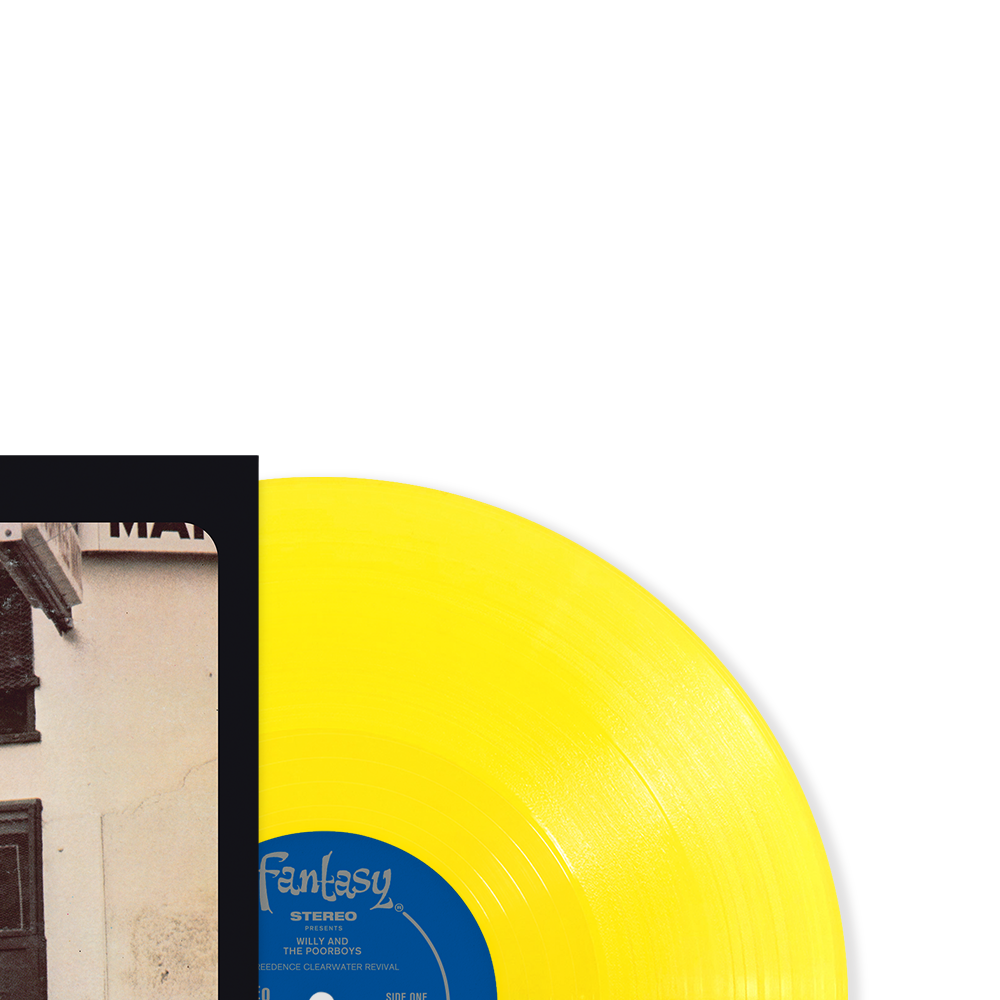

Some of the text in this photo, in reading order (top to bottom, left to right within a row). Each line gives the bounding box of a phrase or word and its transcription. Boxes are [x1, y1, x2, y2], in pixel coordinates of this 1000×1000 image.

[290, 911, 358, 922] STEREO
[296, 937, 349, 946] WILLY AND
[283, 946, 362, 956] THE POORBOYS
[303, 963, 363, 971] CLEARWATER
[364, 963, 400, 971] REVIVAL
